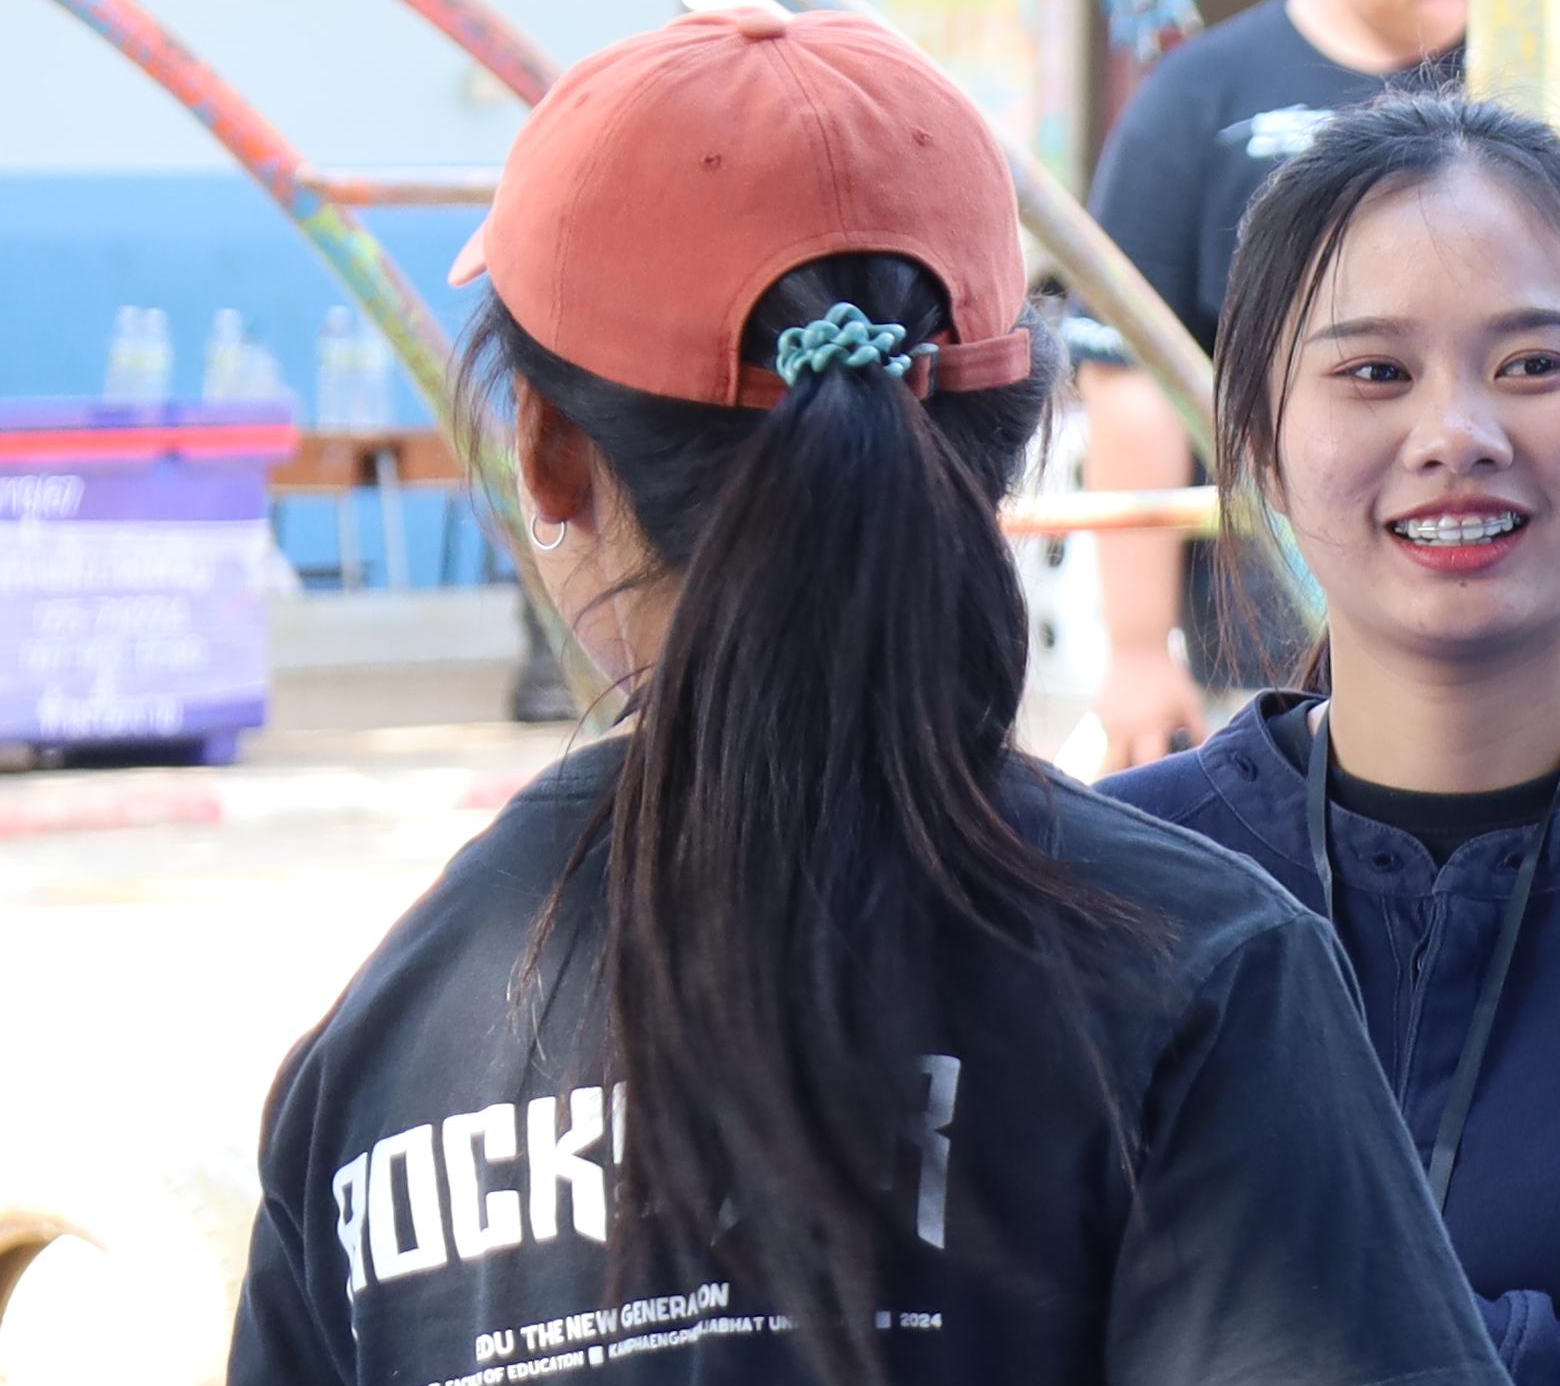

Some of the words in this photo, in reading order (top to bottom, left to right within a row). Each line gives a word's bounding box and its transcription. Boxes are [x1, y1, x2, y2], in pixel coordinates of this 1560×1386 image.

[331, 1053, 962, 1305] ROCKR
[520, 1317, 563, 1353] THE
[564, 1307, 618, 1341] NEW
[620, 1282, 730, 1329] GENERAON
[900, 1312, 942, 1329] 2024
[483, 1366, 504, 1384] OF
